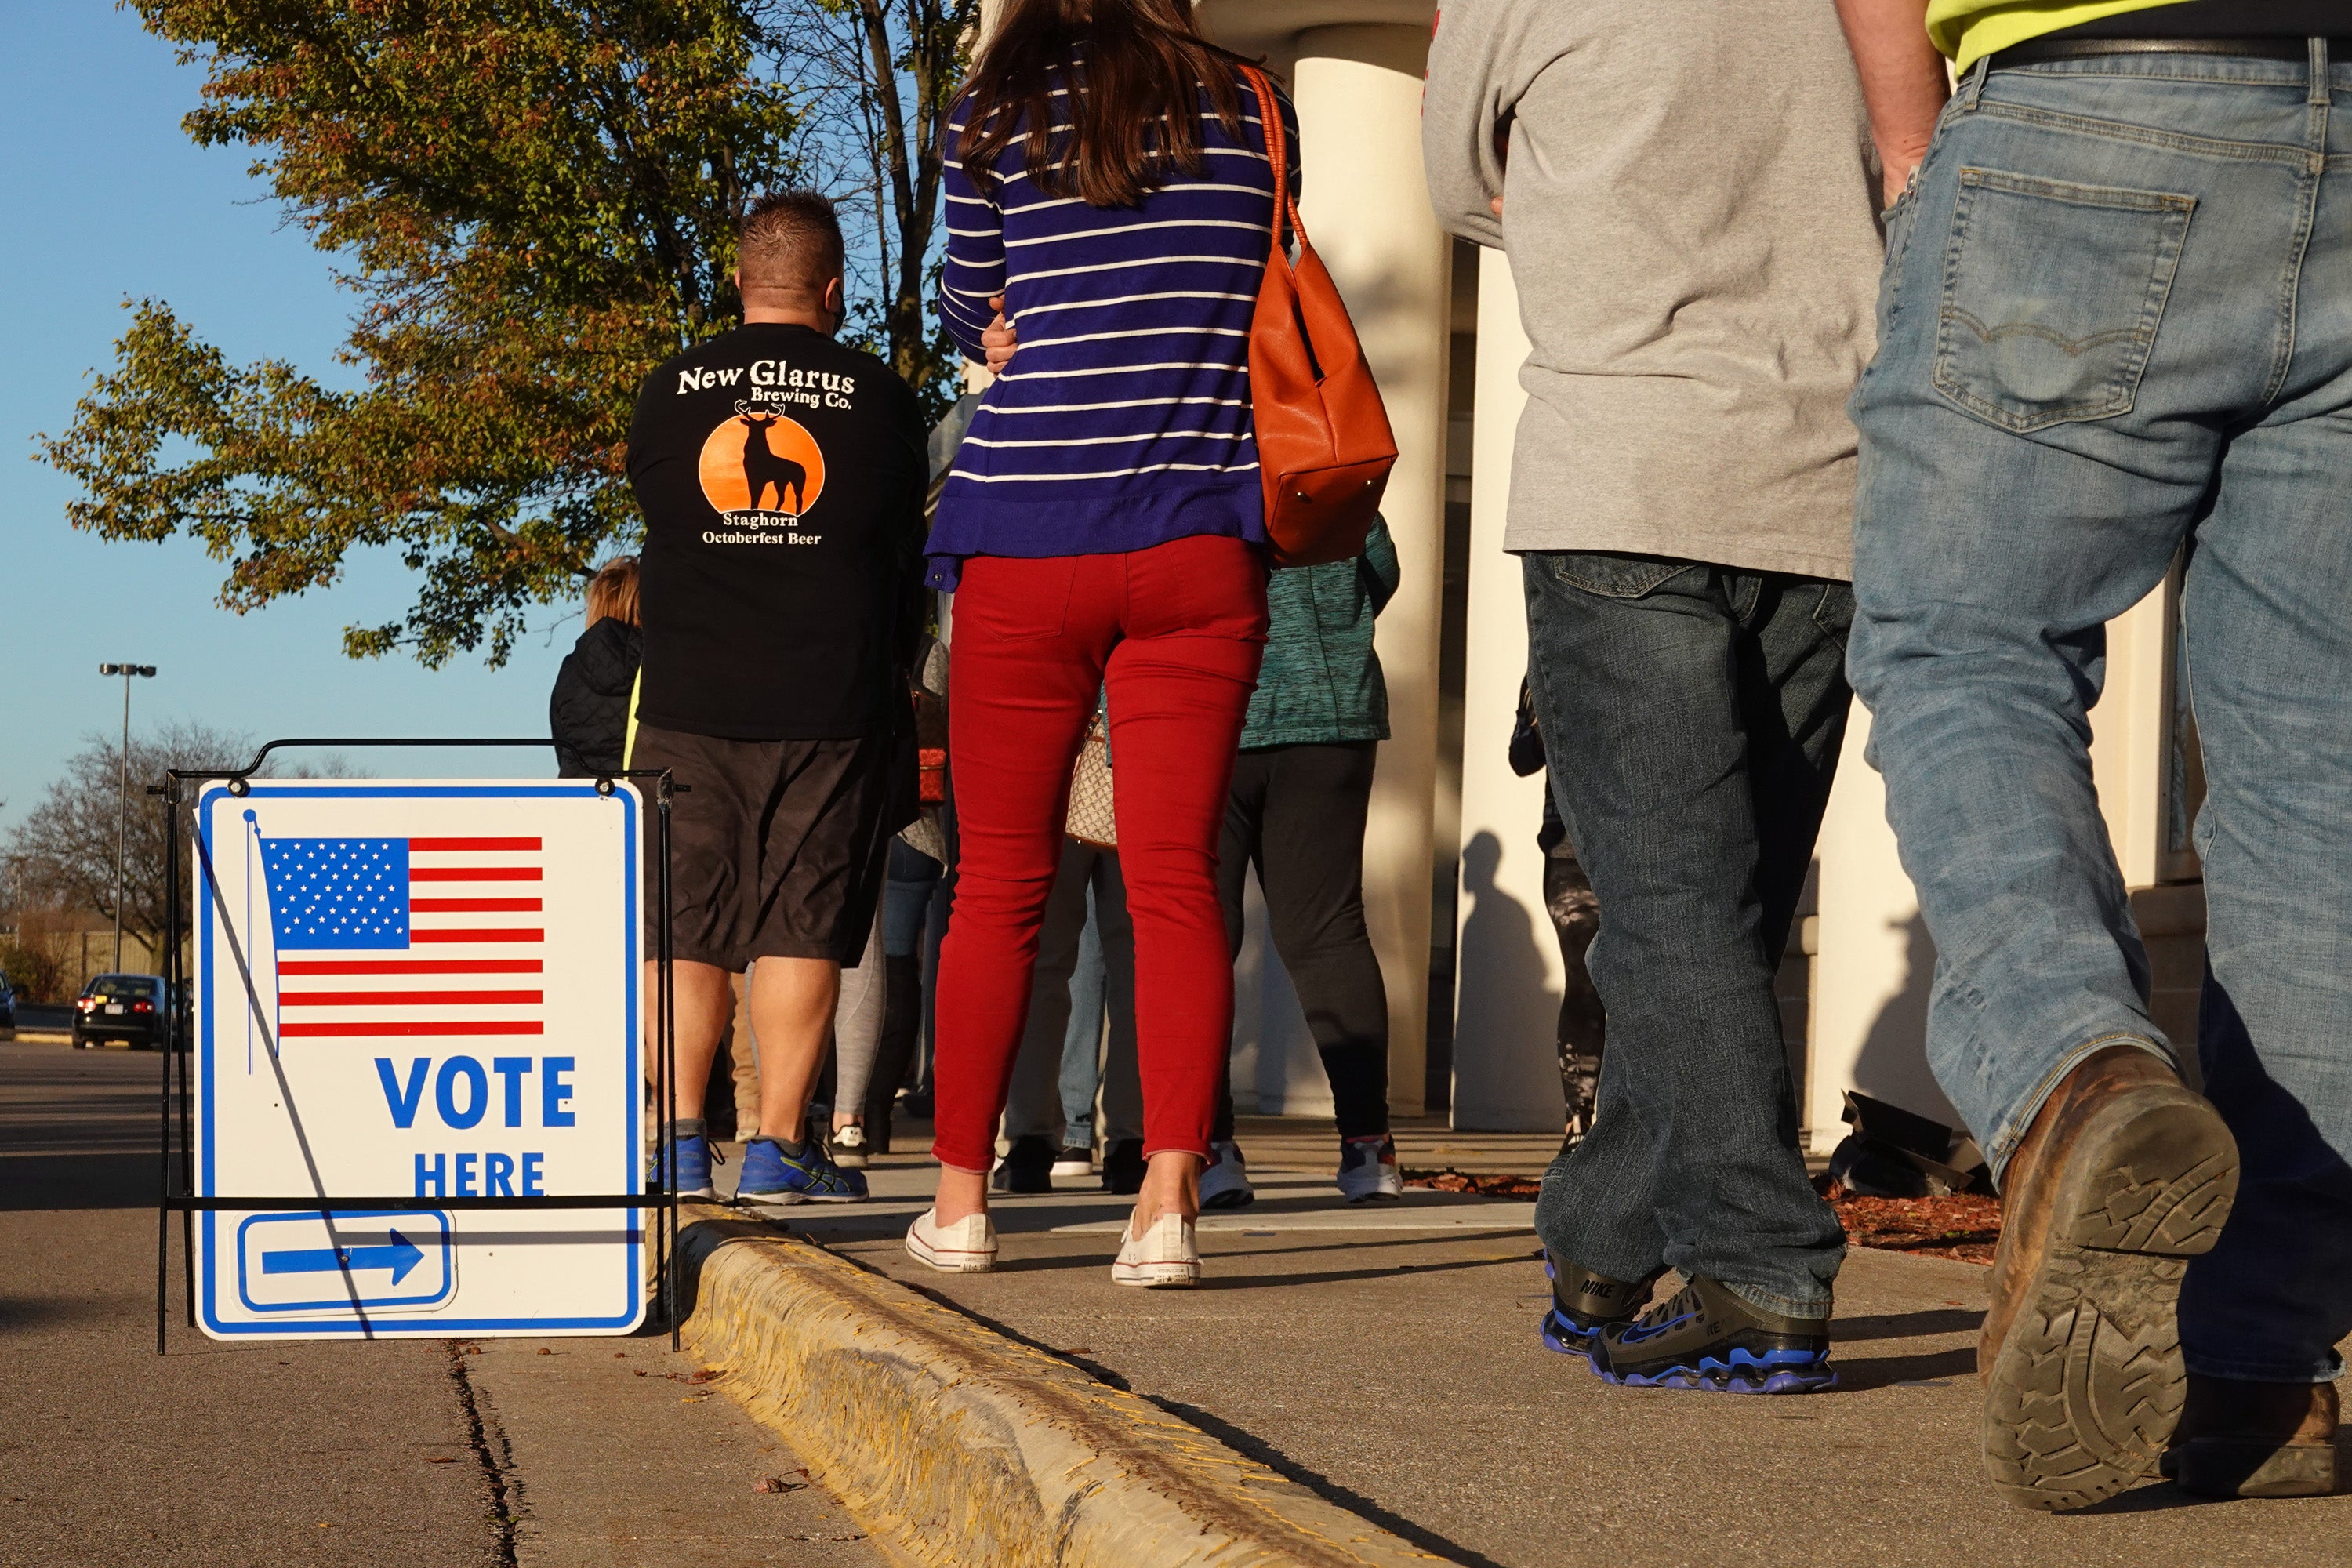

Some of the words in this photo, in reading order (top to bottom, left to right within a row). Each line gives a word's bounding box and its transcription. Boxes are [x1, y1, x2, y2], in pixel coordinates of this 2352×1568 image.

[676, 366, 744, 395] New
[750, 360, 855, 394] Glarus
[751, 387, 821, 409] Brewing
[825, 392, 852, 410] Co.
[723, 512, 798, 530] Staghorn
[702, 531, 784, 544] Octoberfest
[788, 532, 822, 545] Beer
[375, 1055, 575, 1130] VOTE
[415, 1152, 544, 1198] HERE
[1580, 1279, 1615, 1298] NIKE
